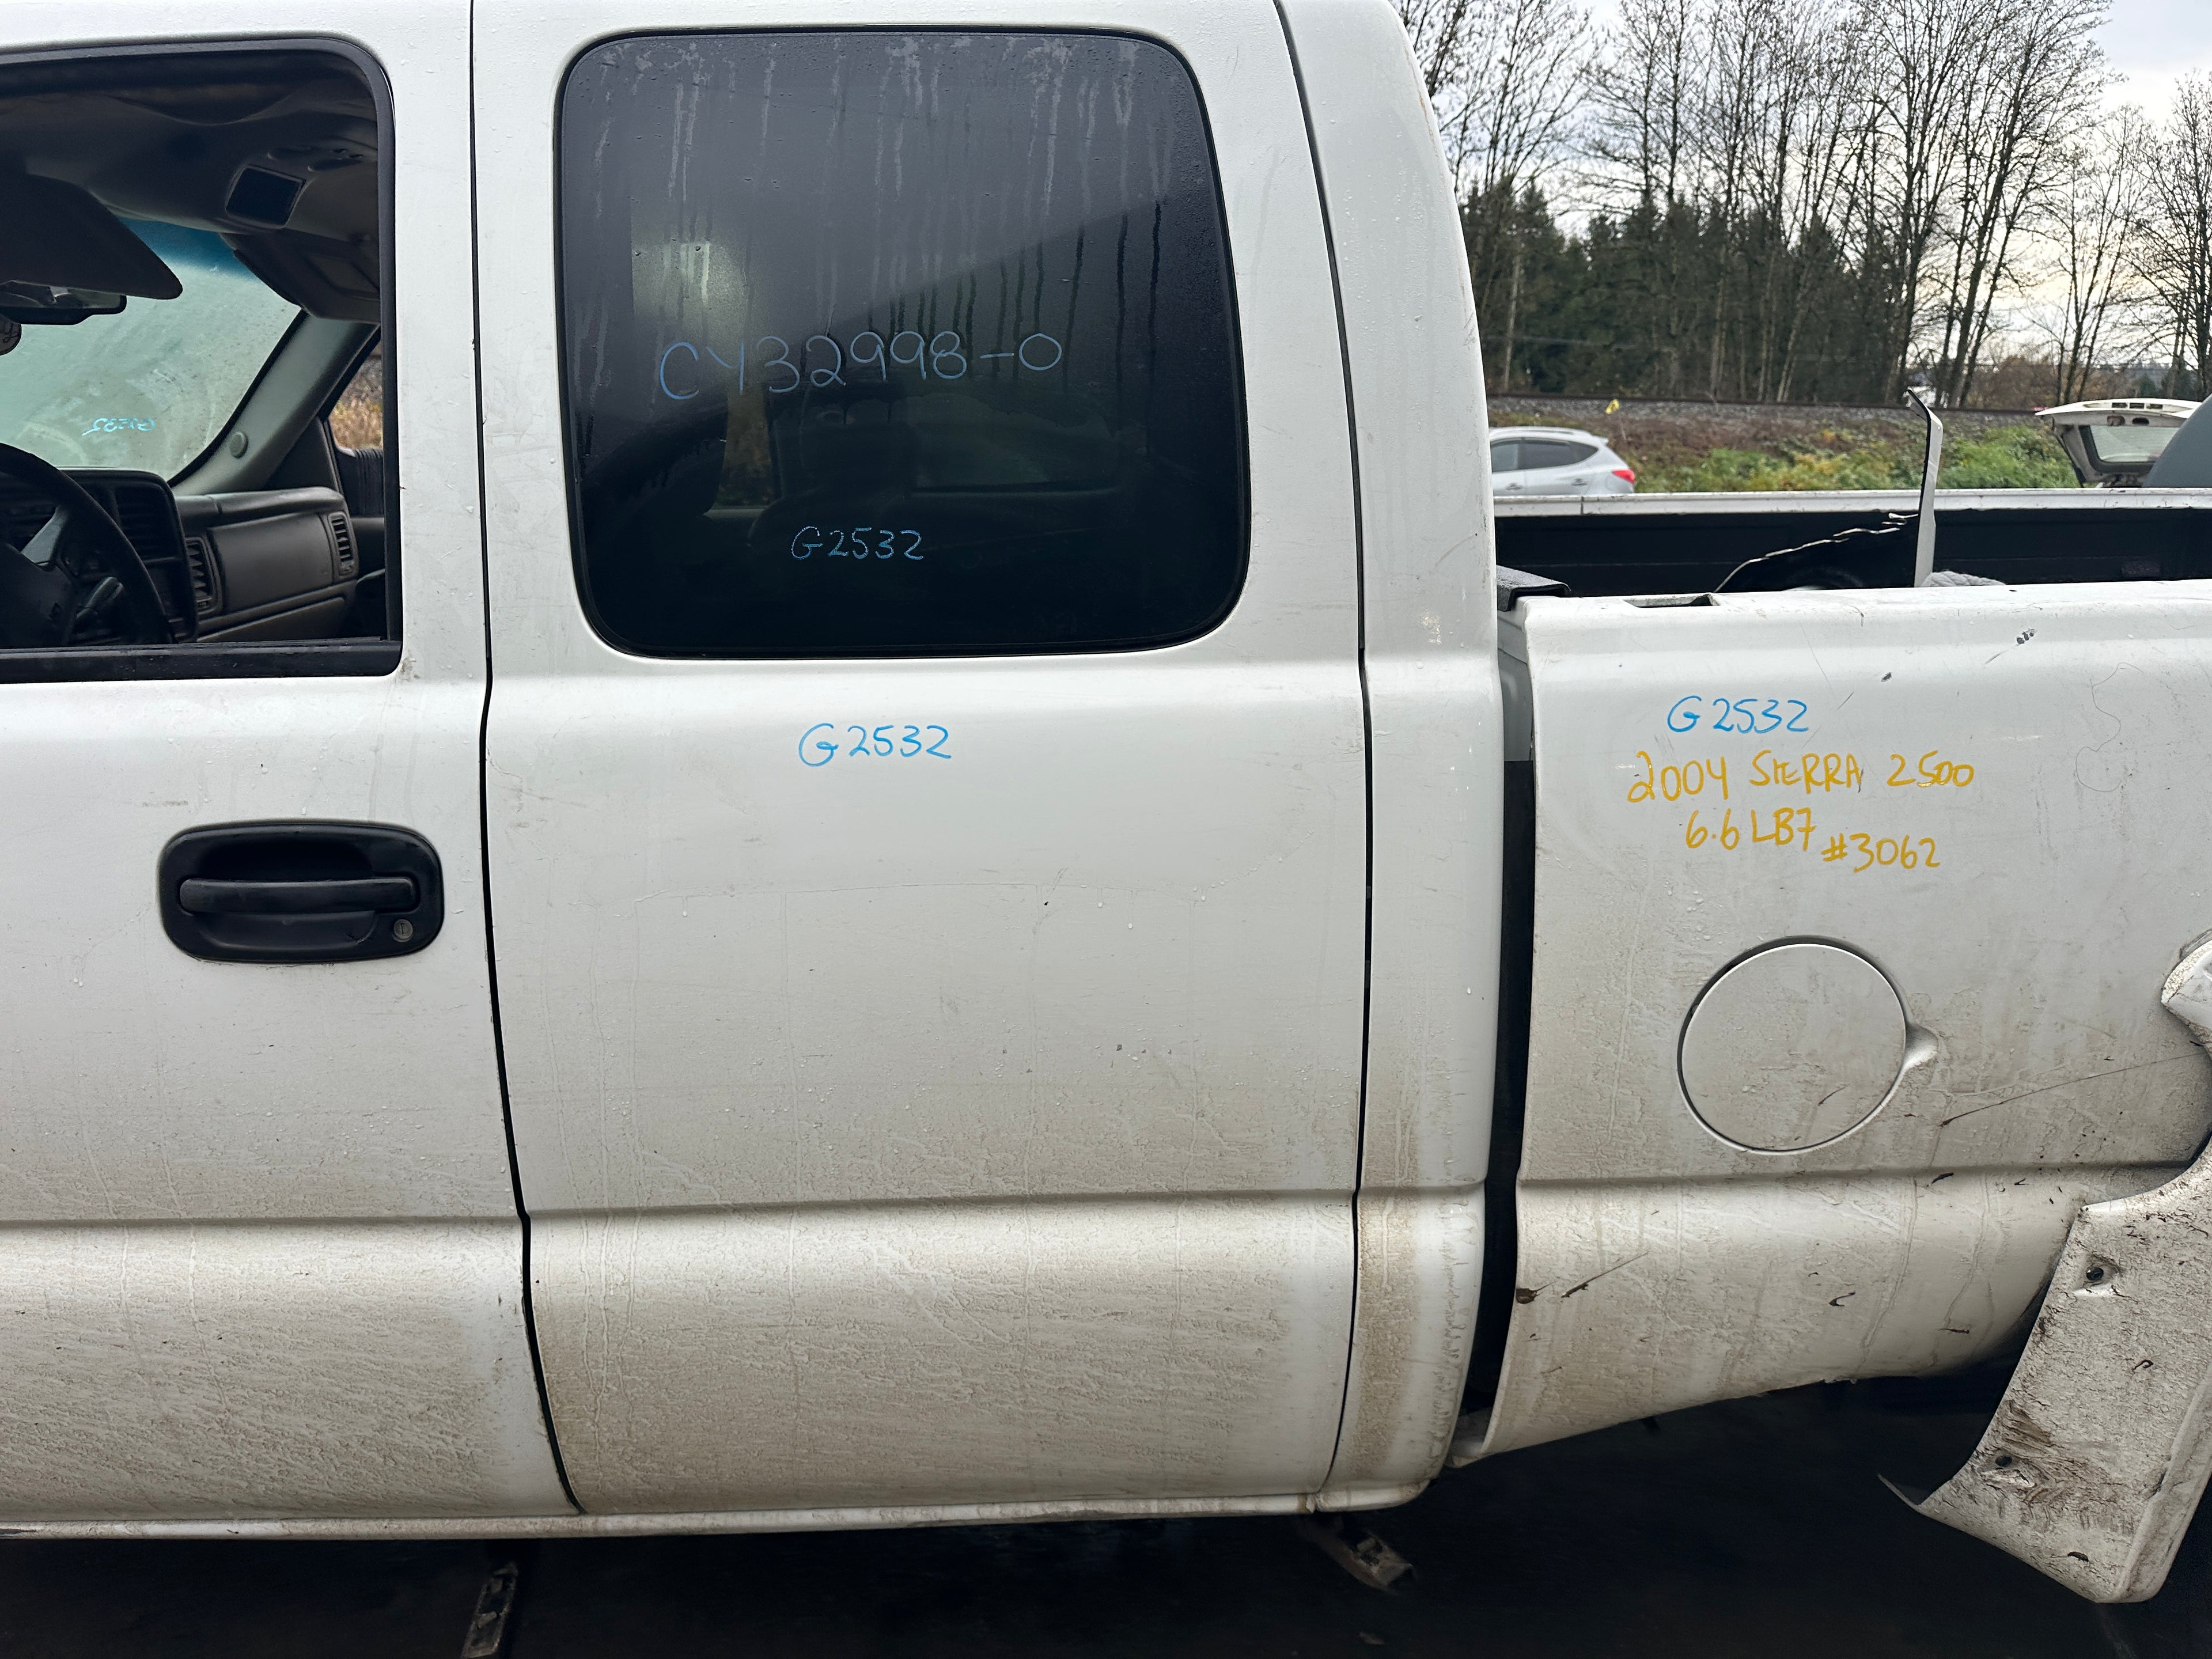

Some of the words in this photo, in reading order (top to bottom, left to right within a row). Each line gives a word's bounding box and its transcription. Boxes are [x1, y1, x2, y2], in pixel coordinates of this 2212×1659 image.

[790, 525, 925, 561] G2532
[1666, 695, 1809, 734] G2532
[798, 722, 952, 767] G2532
[1627, 750, 1729, 802] 2004
[1749, 749, 1863, 794] SIERRA
[1887, 749, 1975, 787] 2500
[1820, 832, 1941, 873] #3062
